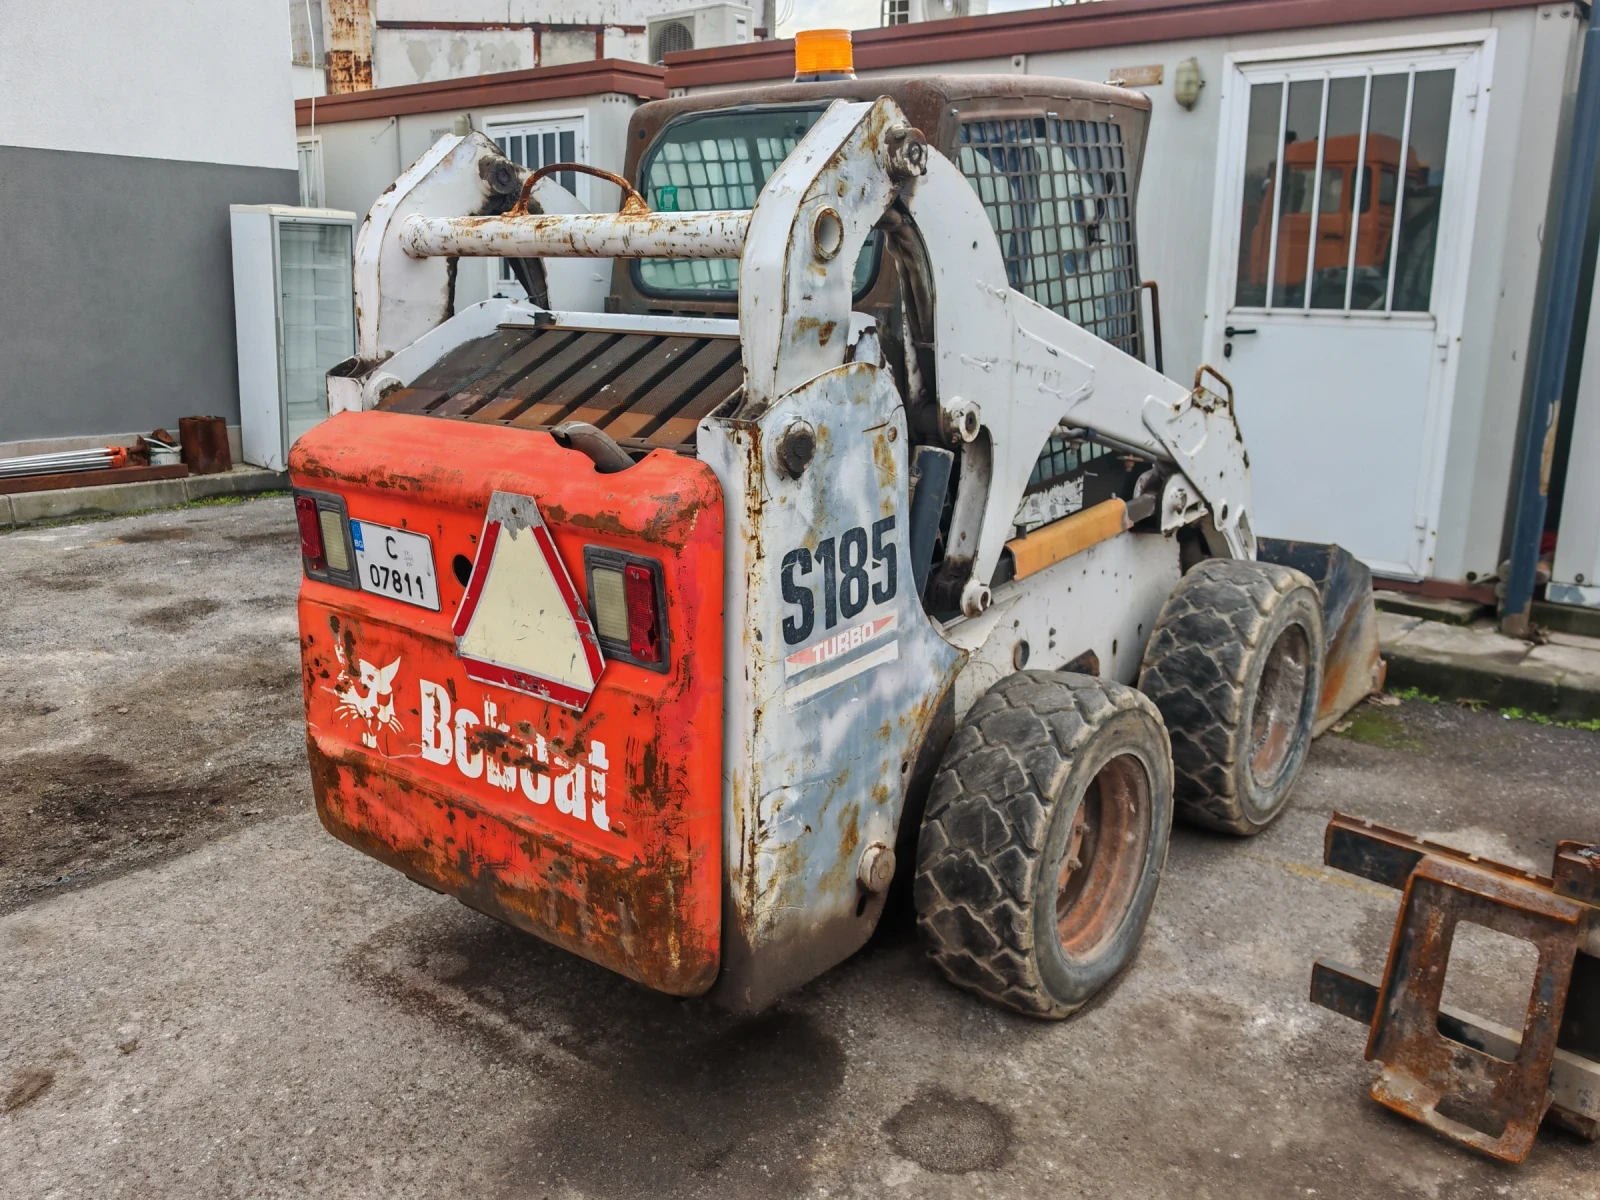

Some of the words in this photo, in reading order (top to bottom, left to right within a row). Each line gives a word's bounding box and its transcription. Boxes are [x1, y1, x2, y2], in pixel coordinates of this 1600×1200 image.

[354, 539, 364, 549] BG
[385, 535, 399, 560] C
[369, 563, 424, 600] 07811
[780, 514, 898, 645] S185
[811, 621, 875, 664] TURBO
